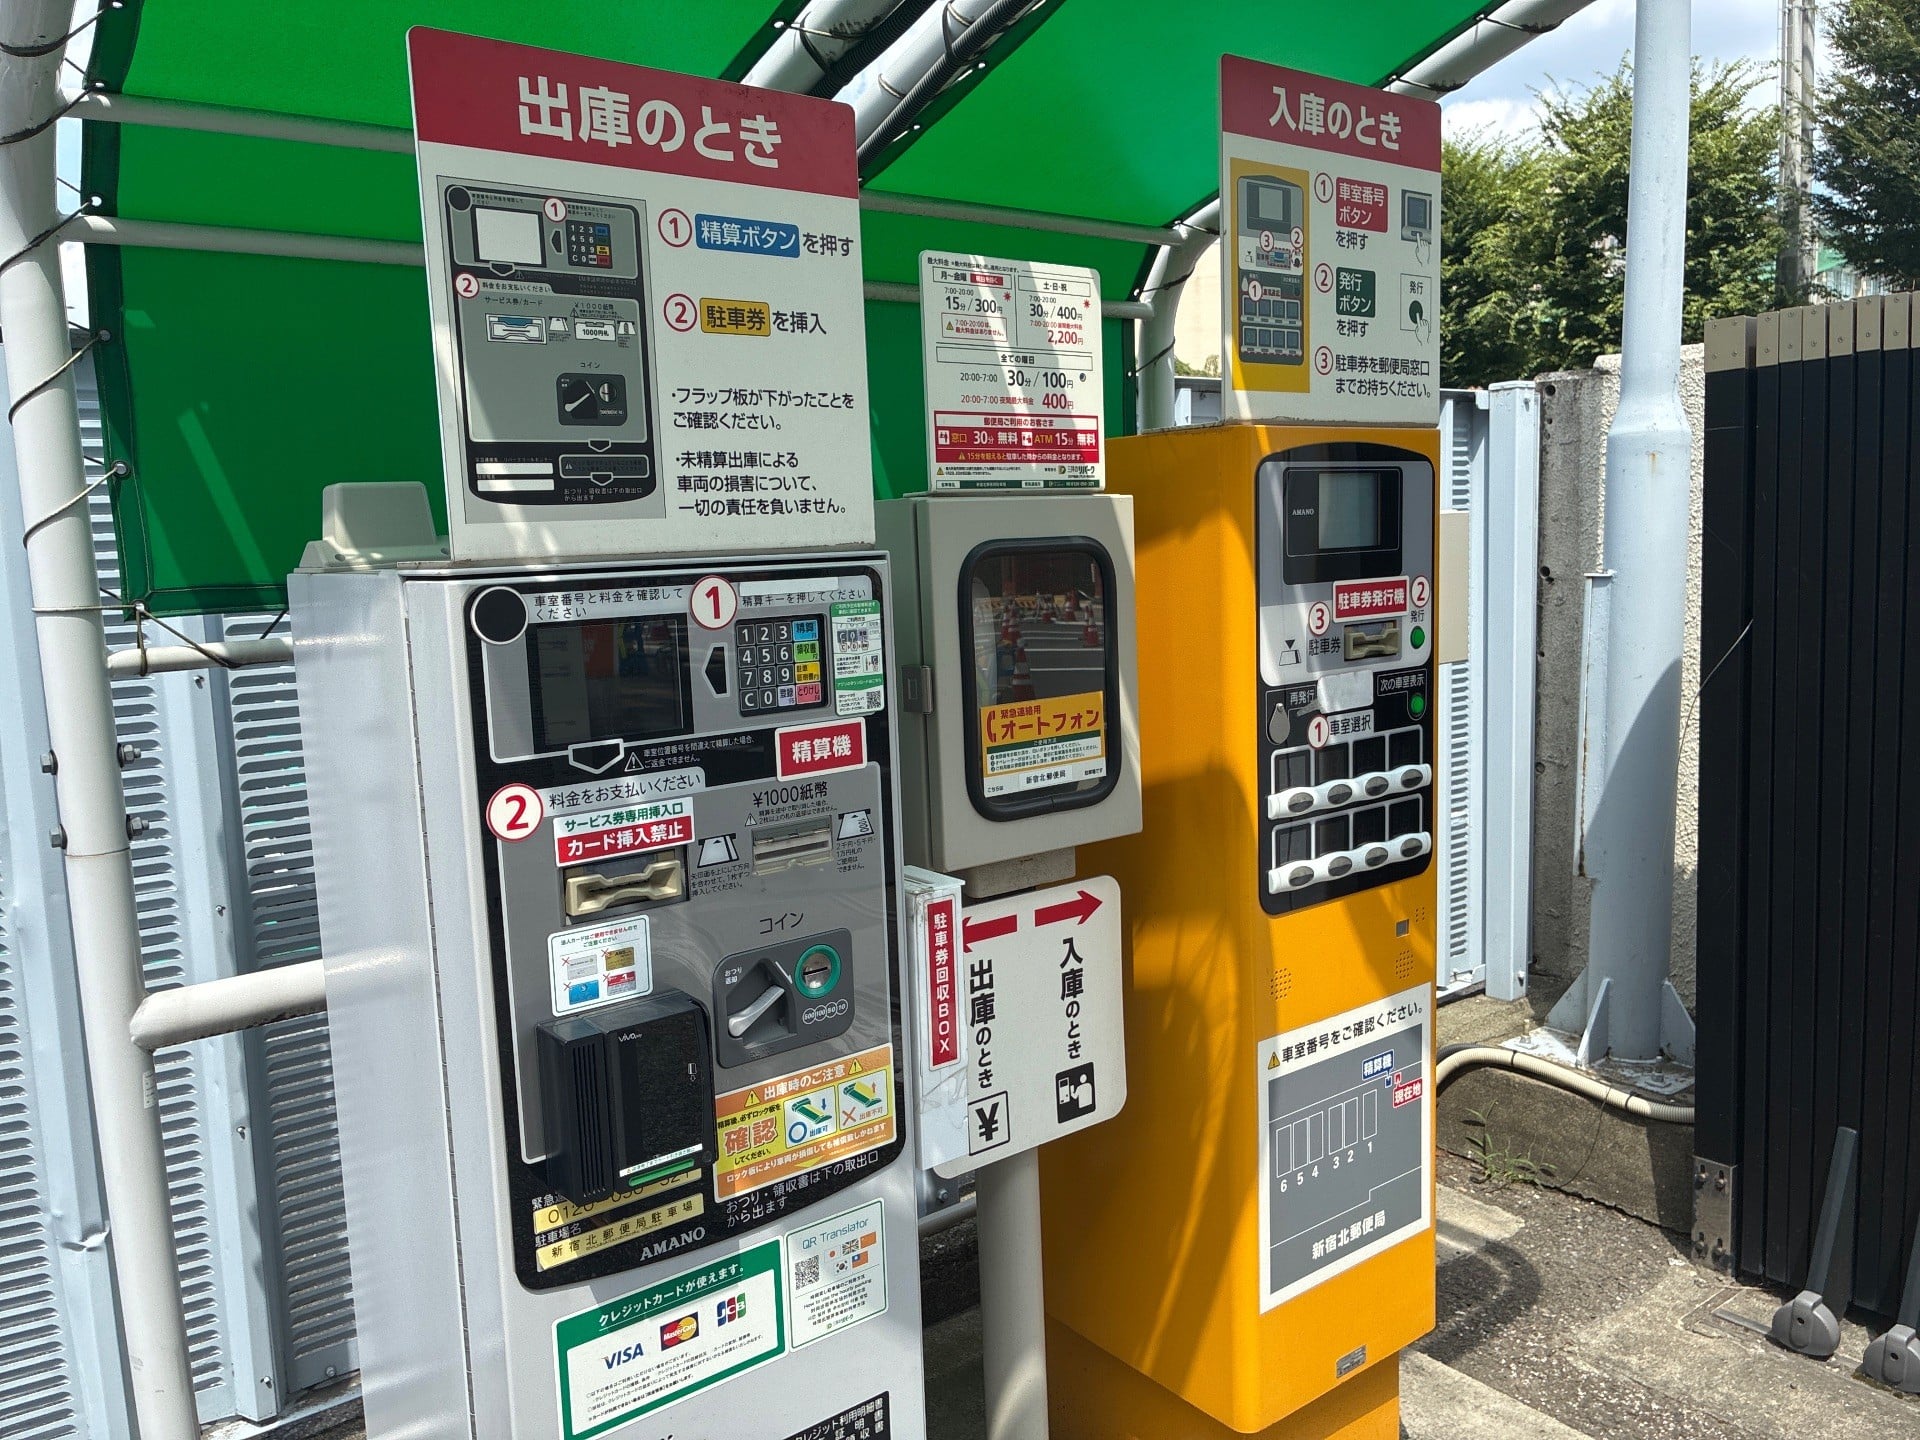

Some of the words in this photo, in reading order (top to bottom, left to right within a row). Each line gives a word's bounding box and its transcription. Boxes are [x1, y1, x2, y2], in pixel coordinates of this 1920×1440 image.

[517, 75, 783, 169] 出庫のとき
[1269, 86, 1402, 150] 入庫のとき
[1338, 182, 1385, 208] 車室番号
[1338, 206, 1373, 233] ボタン
[701, 219, 797, 250] 精算ボタン
[802, 232, 854, 257] を押す
[1336, 230, 1369, 250] を押す
[1339, 272, 1363, 292] 発行
[1409, 281, 1424, 295] 発行
[1339, 293, 1373, 315] ボタン
[706, 305, 766, 331] 駐車券
[772, 310, 827, 335] を挿入
[1336, 318, 1369, 338] を押す
[1047, 330, 1084, 345] 2,200円
[1001, 354, 1035, 364] 全ての曜日
[1335, 354, 1430, 377] 駐車券を郵便局窓口
[960, 372, 998, 383] 20:00-7:00
[1335, 378, 1432, 398] までお持ちください。
[1042, 393, 1074, 410] 400円
[673, 411, 782, 431] ご確認ください。
[983, 417, 1055, 428] 郵便局ご利用のお客さま
[951, 432, 967, 443] 窓口
[997, 431, 1018, 445] 無料
[1034, 434, 1053, 444] ATM
[1076, 433, 1096, 446] 無料
[676, 475, 818, 493] 車両の損害について、
[678, 498, 846, 516] 一切の責任を負いません。
[1292, 508, 1315, 516] AMANO
[534, 587, 684, 608] 車室番号と料金を確認して
[742, 588, 867, 608] 精算キーを押してください
[1337, 587, 1406, 611] 駐車券発行機
[536, 607, 588, 621] ください
[1410, 609, 1425, 623] 発行
[742, 628, 750, 643] 1
[760, 627, 770, 641] 2
[778, 625, 788, 640] 3
[762, 648, 771, 662] 5
[780, 646, 789, 661] 6
[1308, 636, 1341, 657] 駐車券
[742, 650, 752, 664] 4
[744, 671, 753, 686] 7
[762, 669, 772, 684] 8
[781, 668, 791, 682] 9
[1380, 673, 1425, 692] 次の車室表示
[744, 692, 754, 707] C
[763, 691, 773, 705] 0
[797, 684, 820, 697] とりけし
[1289, 689, 1315, 705] 再発行
[1000, 705, 1041, 719] 緊急連絡用
[1001, 709, 1100, 740] オートフォン
[1330, 714, 1371, 736] 車室選択
[792, 734, 852, 764] 精算機
[1026, 770, 1066, 784] 新宿北郵便局
[549, 774, 701, 810] 料金をお支払いください
[752, 780, 829, 808] ¥1000紙幣
[564, 802, 684, 832] サービス券専用挿入口
[567, 821, 684, 857] カード挿入禁止
[759, 912, 804, 935] コイン
[724, 966, 743, 977] おつり
[933, 912, 950, 1053] 駐車券回収BOX
[1060, 937, 1084, 1060] 入庫のとき
[969, 959, 996, 1089] 出庫のとき
[1282, 1002, 1422, 1063] 車室番号をご確認ください。
[1363, 1053, 1392, 1076] 精算機
[764, 1065, 845, 1100] 出庫時のご注意
[1394, 1081, 1421, 1105] 現在地
[859, 1108, 883, 1120] 出庫不可
[975, 1102, 1000, 1142] ¥
[723, 1117, 778, 1156] 確認
[809, 1124, 828, 1137] 出庫可
[1346, 1149, 1354, 1163] 2
[1368, 1141, 1373, 1154] 1
[1311, 1165, 1319, 1178] 4
[1332, 1156, 1340, 1169] 3
[726, 1150, 879, 1214] おつり・領収書は下の取出口
[1280, 1180, 1287, 1193] 6
[1296, 1172, 1304, 1186] 5
[727, 1195, 788, 1228] から出ます
[535, 1222, 582, 1248] 駐車場名
[551, 1200, 693, 1258] 新宿北郵便局駐車場
[802, 1236, 817, 1250] QR
[820, 1219, 869, 1243] Translator
[1312, 1209, 1386, 1259] 新宿北郵便局
[639, 1226, 706, 1262] AMANO
[599, 1262, 744, 1328] クレジットカードが使えます。
[664, 1322, 696, 1341] MasterCard
[604, 1342, 644, 1370] VISA
